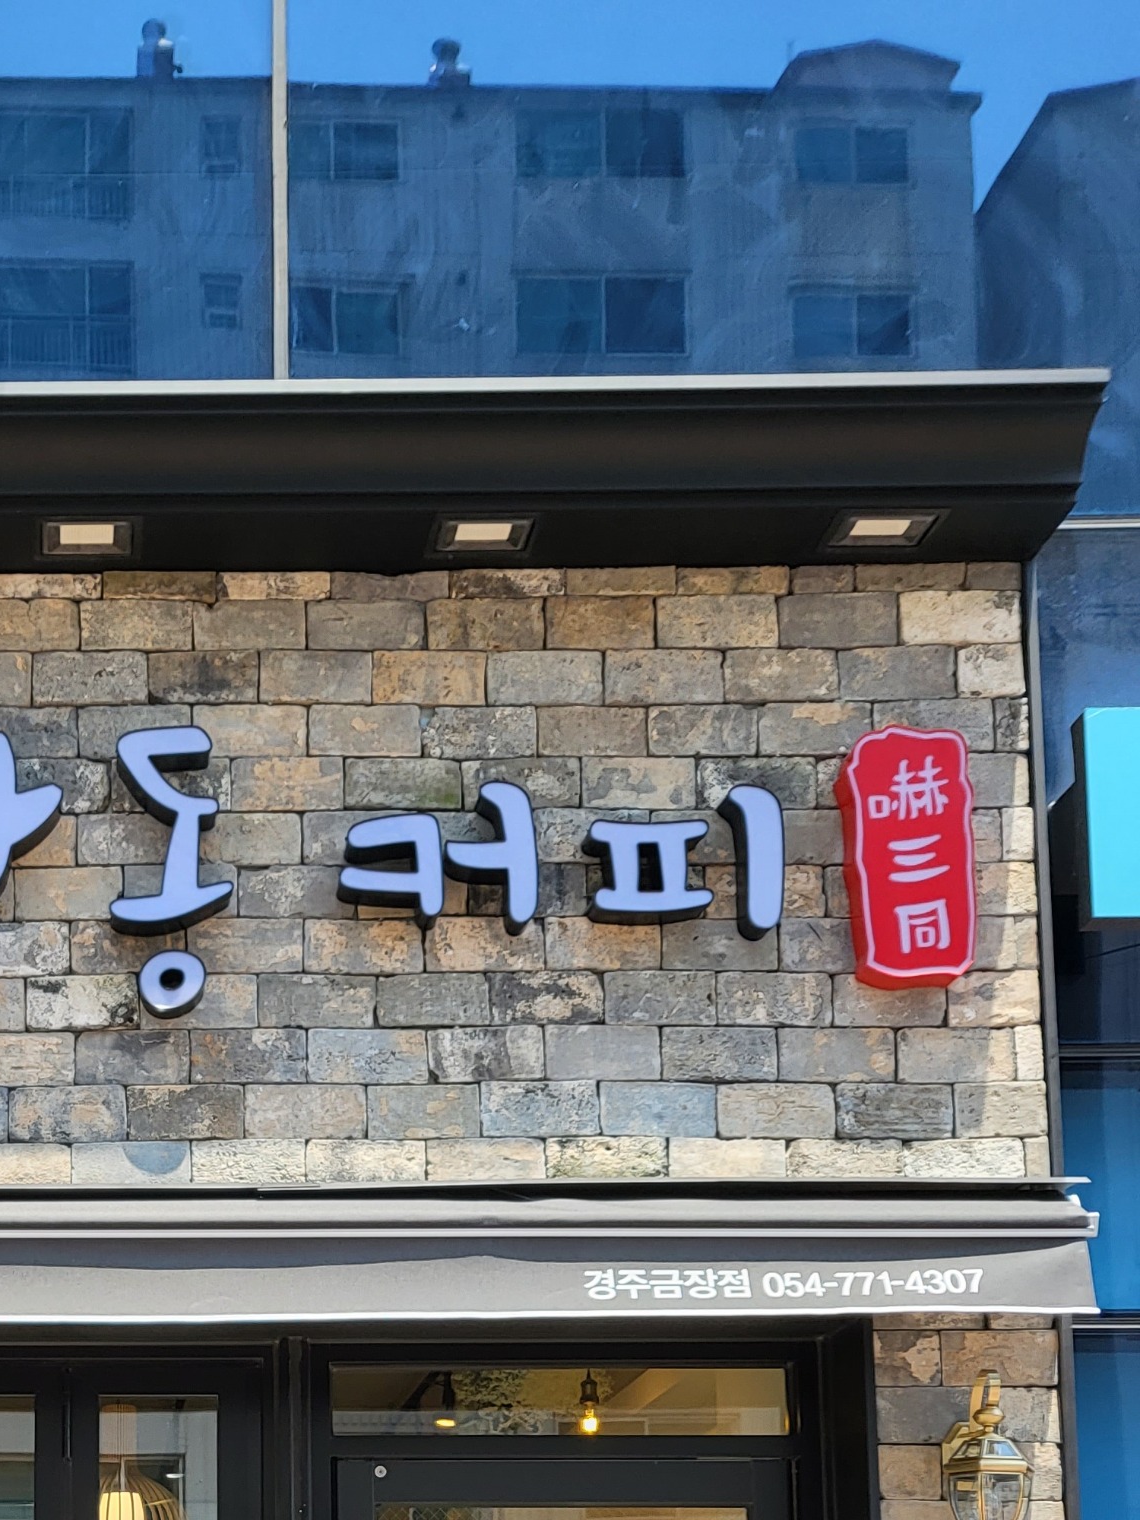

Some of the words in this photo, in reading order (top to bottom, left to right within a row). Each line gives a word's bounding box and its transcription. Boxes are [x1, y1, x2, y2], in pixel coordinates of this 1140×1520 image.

[336, 781, 786, 940] 커피
[583, 1268, 753, 1299] 경주금장점
[762, 1268, 984, 1299] 054-771-4307
